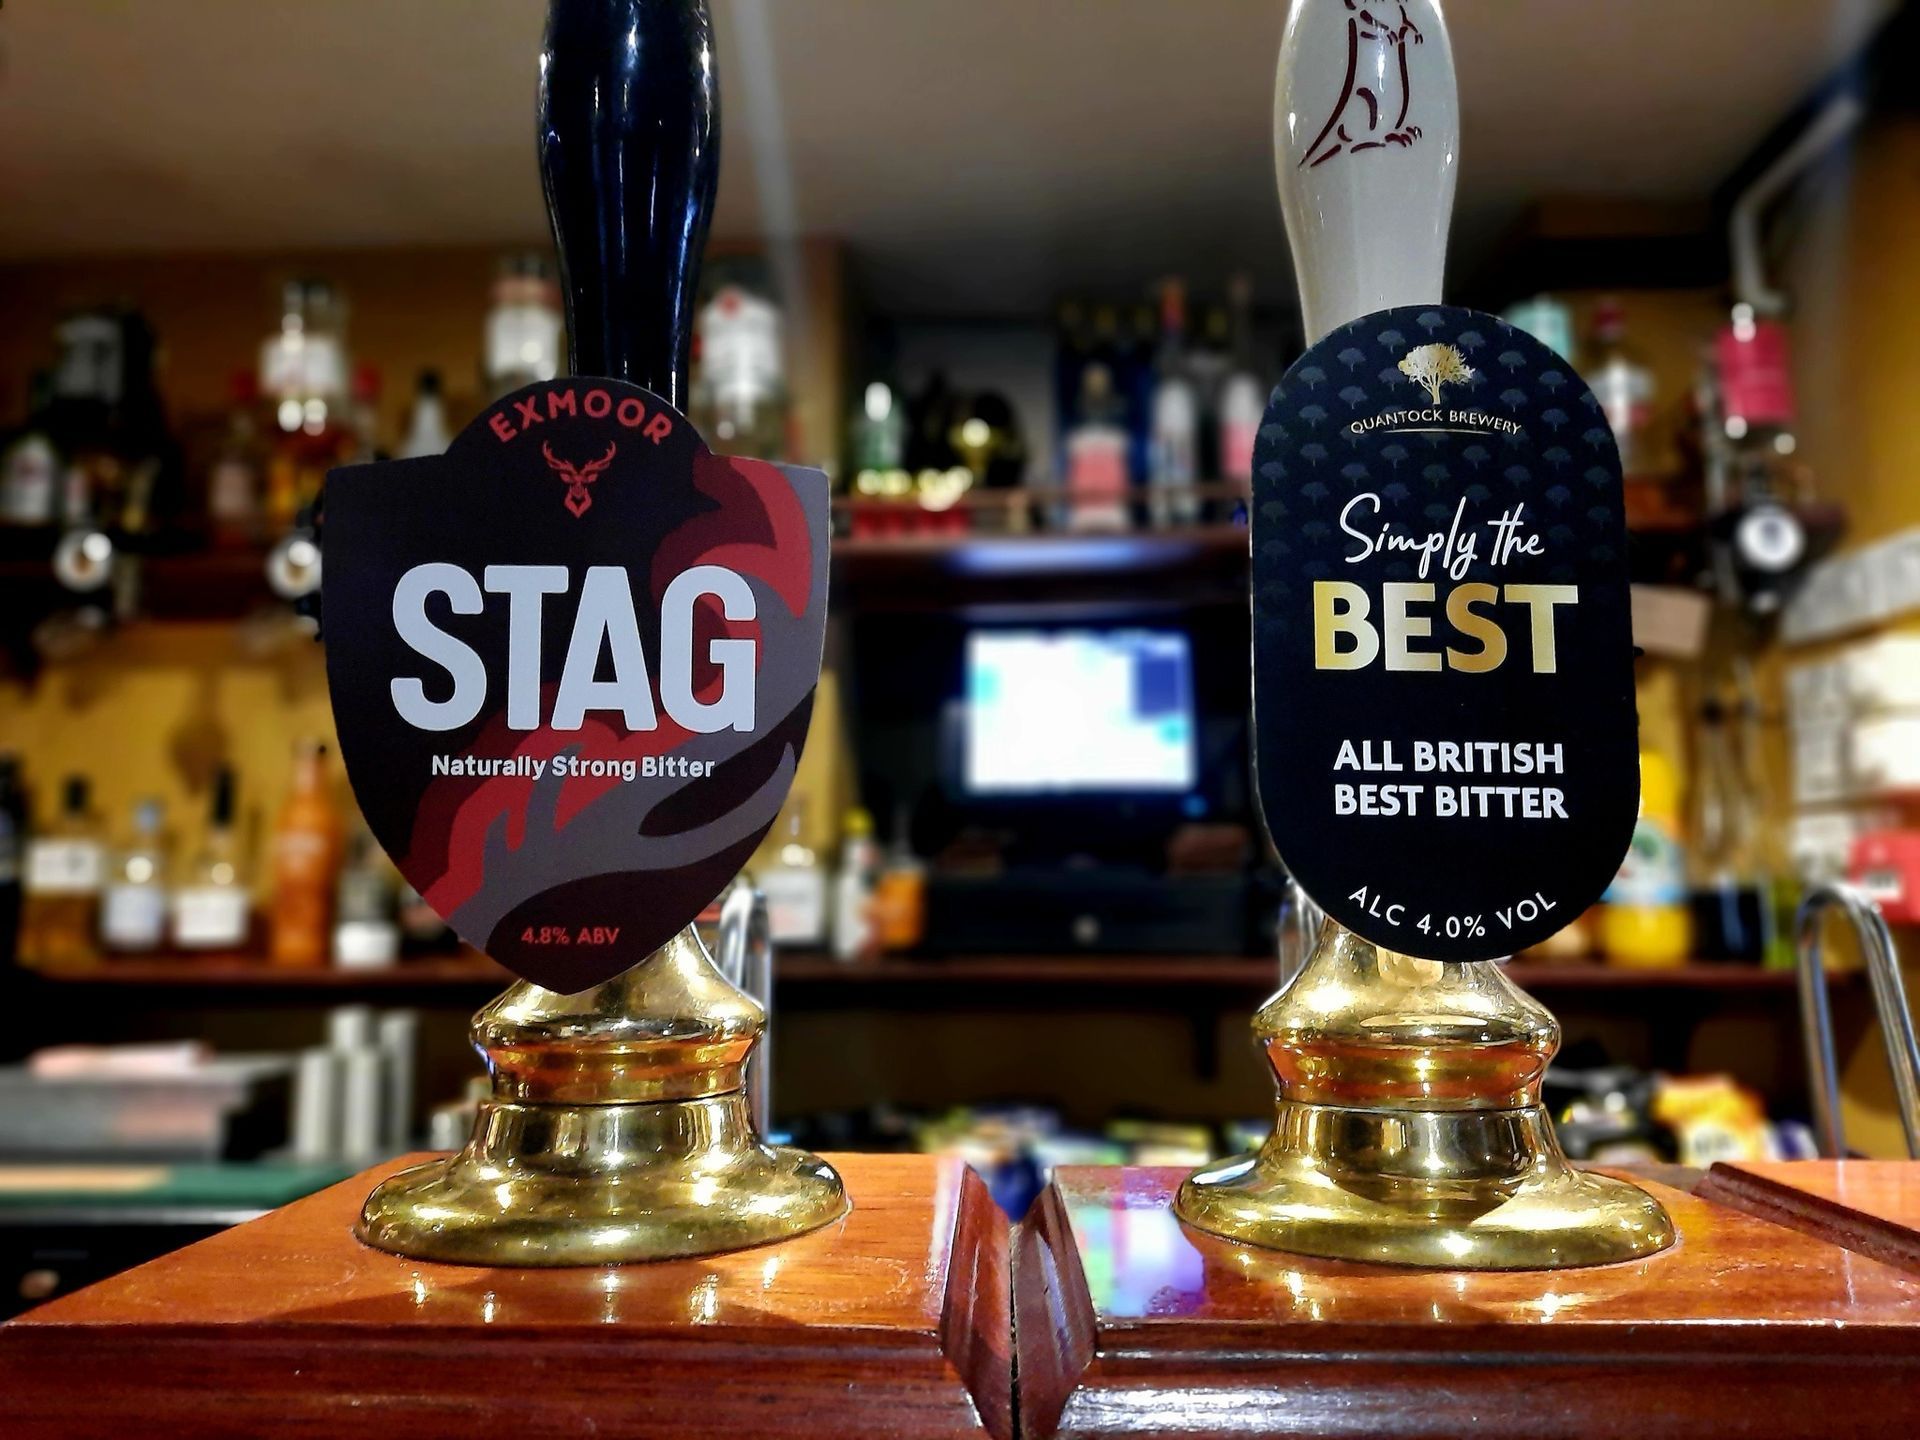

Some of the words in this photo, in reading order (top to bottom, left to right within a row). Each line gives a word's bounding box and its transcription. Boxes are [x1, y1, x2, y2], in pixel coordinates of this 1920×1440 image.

[489, 388, 673, 445] EXMOOR
[1350, 409, 1443, 434] QUANTOCK
[1449, 409, 1522, 435] BREWERY
[1339, 492, 1479, 580] Simply
[1487, 502, 1545, 566] the
[390, 562, 757, 734] STAG
[1313, 580, 1579, 675] BEST
[432, 755, 546, 781] Naturally
[551, 755, 637, 781] Strong
[641, 755, 716, 778] Bitter
[1333, 739, 1404, 772] ALL
[1413, 740, 1564, 774] BRITISH
[1334, 783, 1424, 817] BEST
[1435, 785, 1569, 819] BITTER
[1348, 884, 1406, 928] ALC
[1416, 912, 1486, 939] 4.0%
[1495, 891, 1557, 932] VOL
[520, 926, 570, 945] 4.8%
[577, 927, 619, 944] ABV
